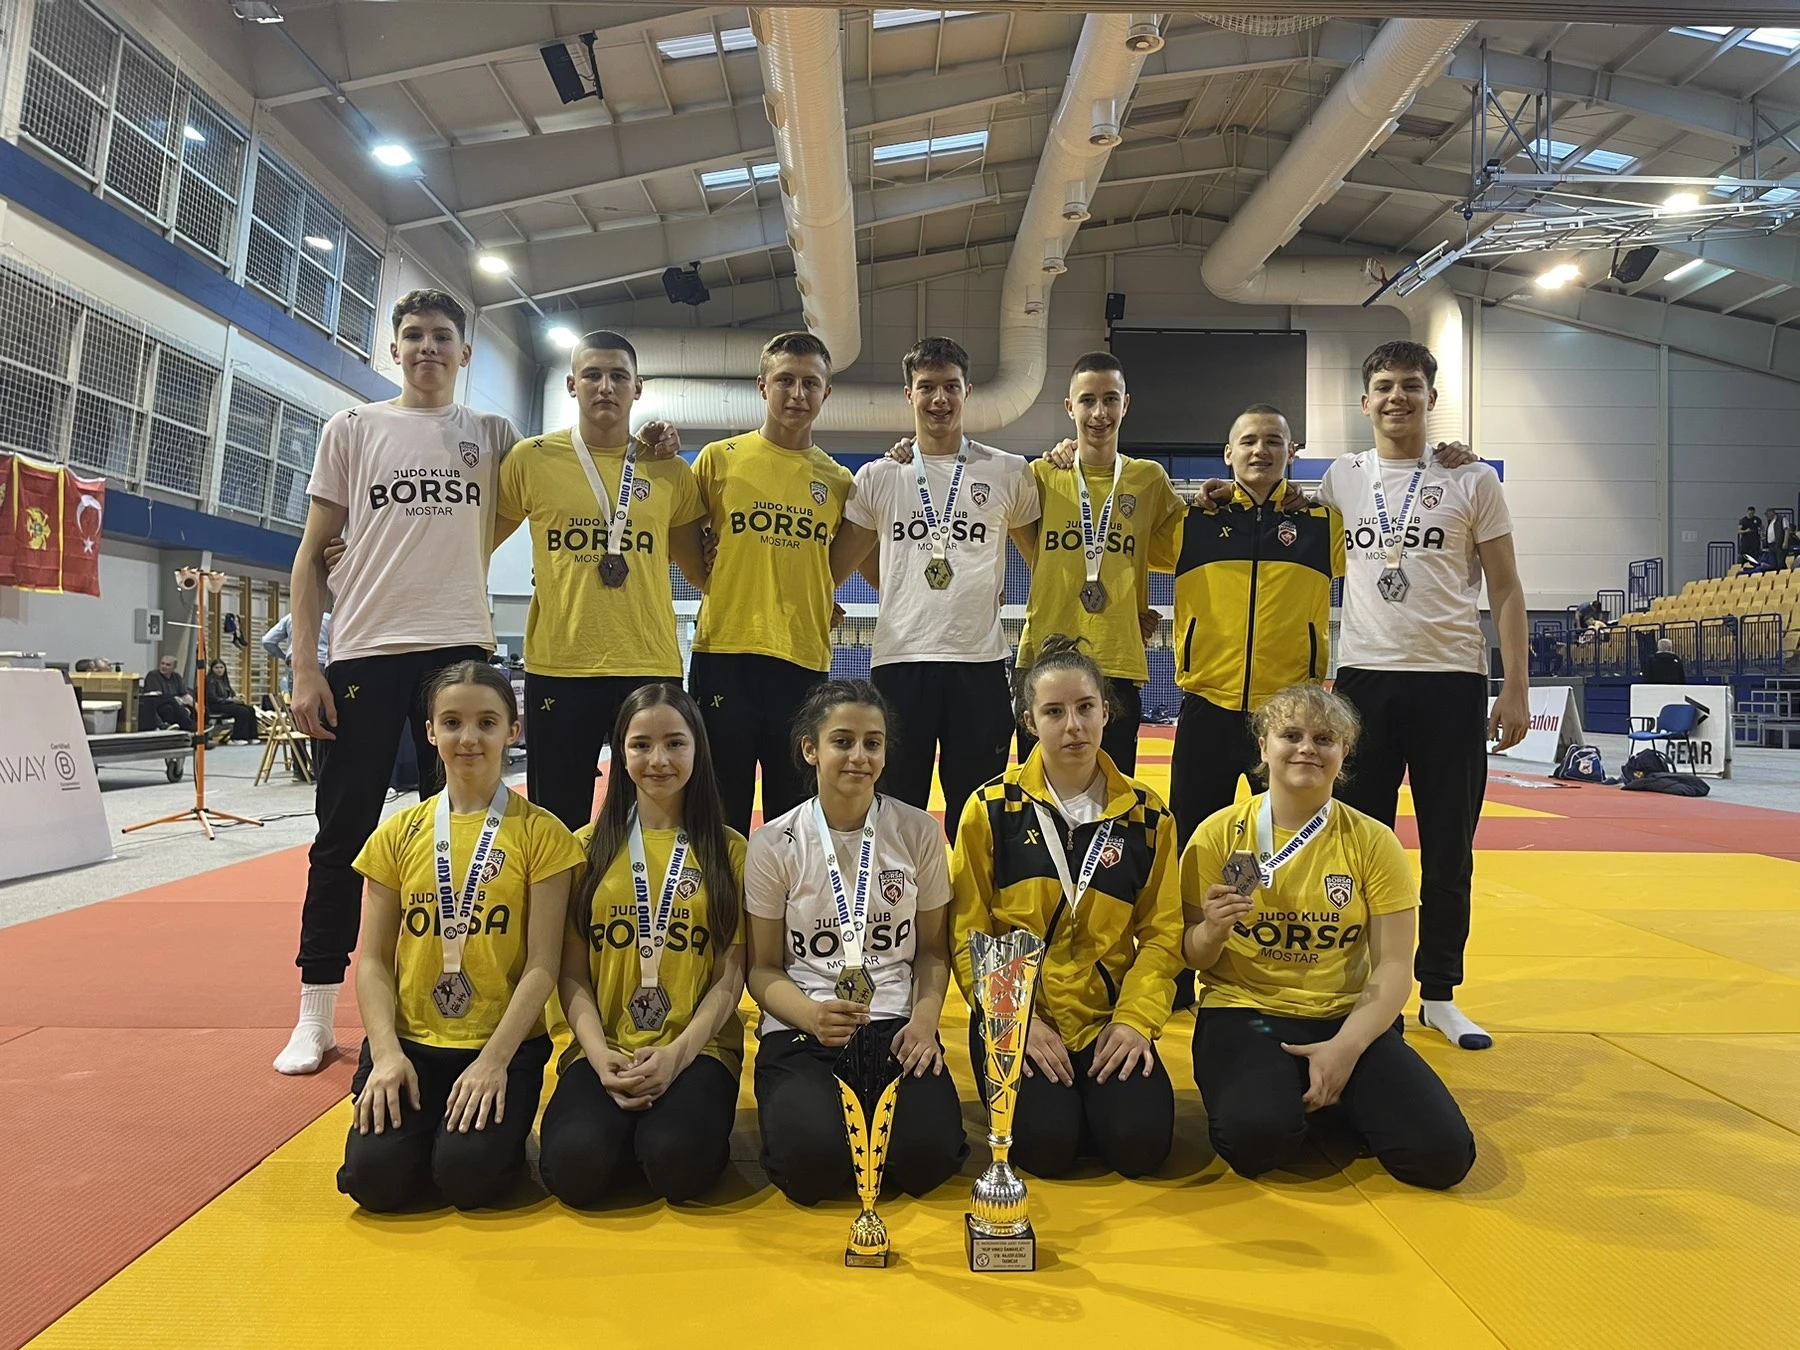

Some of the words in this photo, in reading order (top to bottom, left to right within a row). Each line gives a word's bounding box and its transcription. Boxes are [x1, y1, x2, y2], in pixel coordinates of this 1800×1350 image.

[393, 468, 427, 480] JUDO
[430, 468, 461, 478] KLUB
[624, 464, 634, 484] KUP
[951, 464, 964, 486] VINKO
[1408, 471, 1422, 494] VINKO
[369, 479, 481, 510] BORSA
[619, 485, 631, 507] JUDO
[919, 487, 929, 505] KUP
[1374, 492, 1386, 511] KUP
[405, 506, 453, 517] MOSTAR
[752, 501, 783, 511] JUDO
[786, 505, 814, 517] KLUB
[911, 510, 940, 519] JUO
[924, 505, 937, 528] JUDO
[1082, 501, 1091, 520] KUP
[568, 518, 600, 527] JUDO
[603, 518, 633, 527] KB
[730, 510, 828, 546] BORSA
[893, 519, 986, 544] BOSA
[1357, 517, 1380, 527] JUD
[1391, 516, 1421, 524] KB
[1377, 511, 1391, 534] JUDO
[547, 528, 654, 554] BORSA
[760, 535, 801, 549] MOSTAR
[1045, 529, 1136, 557] BOSA
[1083, 522, 1094, 546] JUDO
[574, 554, 604, 563] MOS
[917, 543, 958, 551] MOAR
[1365, 551, 1408, 561] MOSR
[1529, 714, 1560, 731] anon
[1666, 741, 1712, 765] GEAR
[1300, 815, 1324, 839] VINKO
[475, 831, 493, 862] VINKO
[860, 840, 871, 869] VINKO
[1082, 830, 1108, 877] ŠAMARLIĆ
[437, 856, 451, 883] KUP
[669, 847, 684, 876] VINKO
[459, 862, 483, 918] ŠAMARLIĆ
[634, 876, 648, 903] KUP
[830, 869, 842, 894] KUP
[853, 869, 869, 917] ŠAMARLIĆ
[440, 885, 455, 920] JUDO
[610, 905, 637, 918] JUD
[655, 877, 677, 931] ŠAMARLIĆ
[836, 894, 850, 925] JUDO
[401, 904, 510, 938] OSA
[637, 905, 651, 939] JUDO
[814, 918, 841, 930] JUD
[866, 912, 891, 924] LUB
[1257, 911, 1298, 922] JUDO
[1301, 911, 1340, 922] KLUB
[589, 918, 710, 957] BOSA
[826, 955, 880, 970] MOAR
[1260, 947, 1319, 963] MOSTAR
